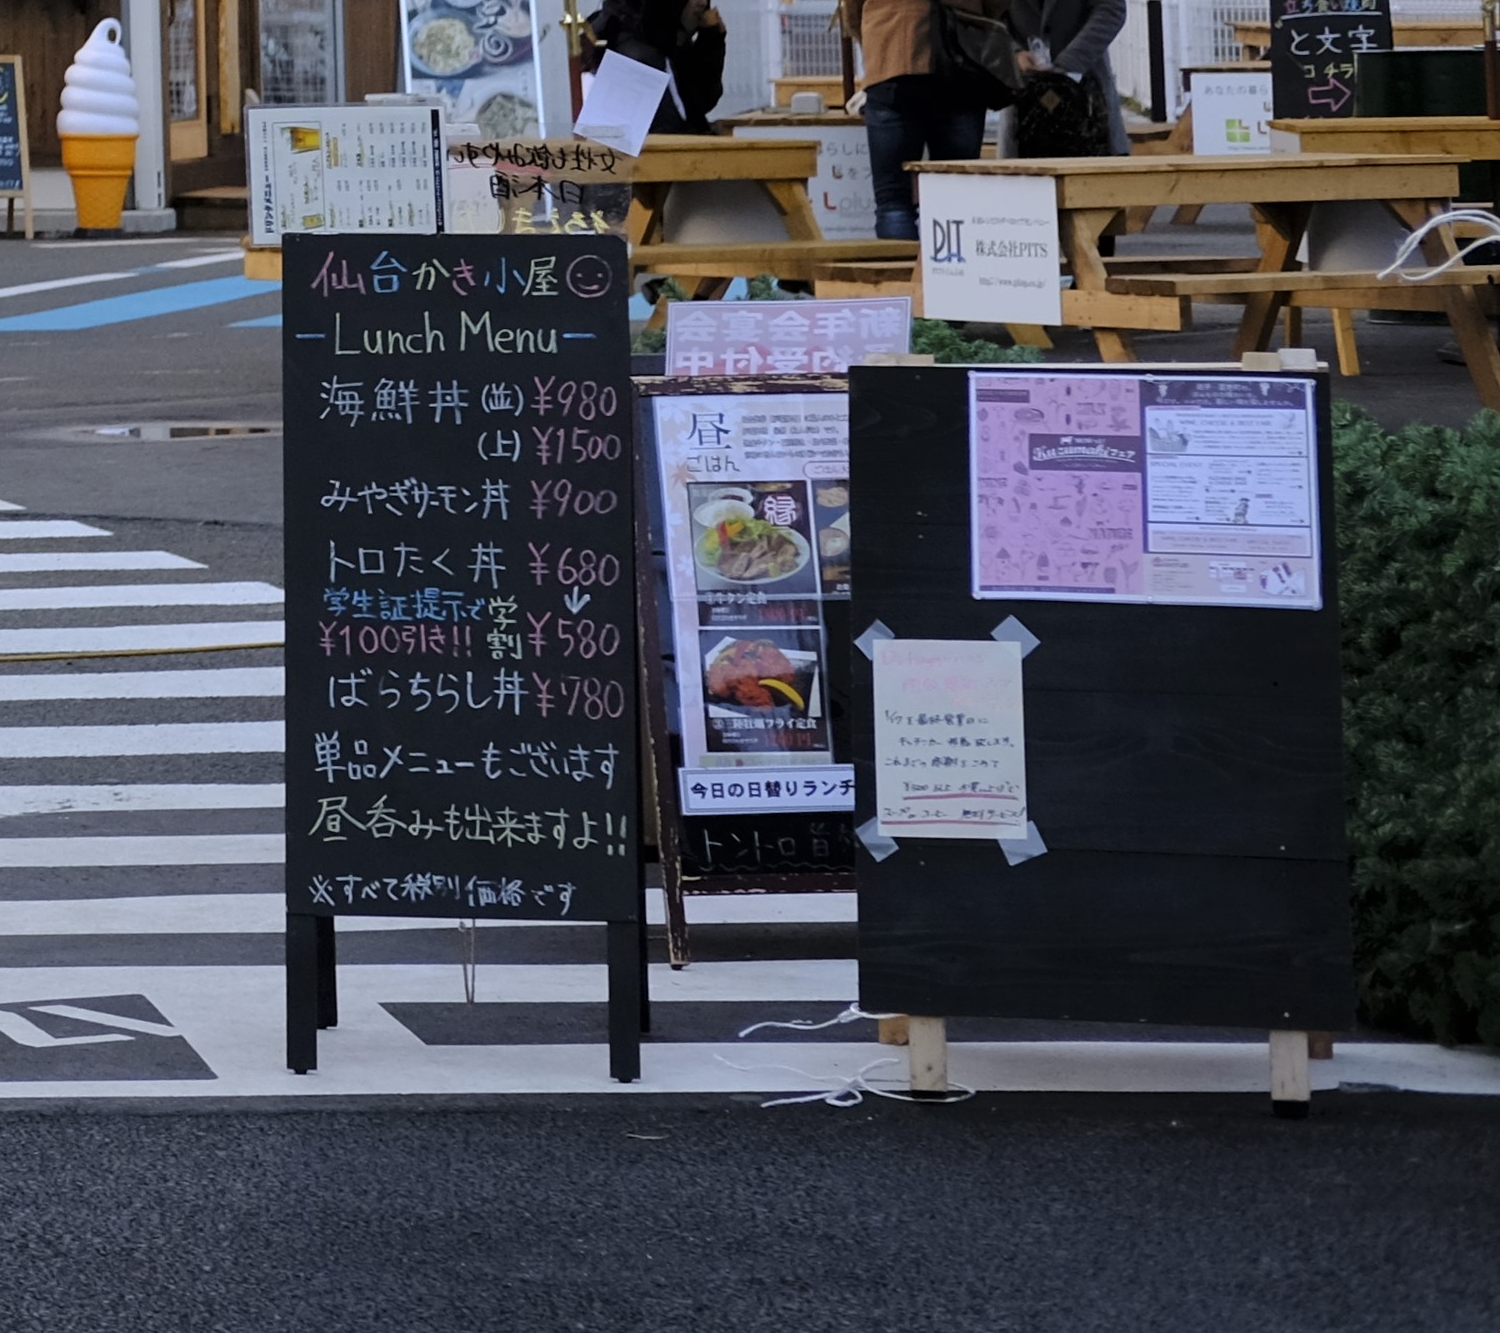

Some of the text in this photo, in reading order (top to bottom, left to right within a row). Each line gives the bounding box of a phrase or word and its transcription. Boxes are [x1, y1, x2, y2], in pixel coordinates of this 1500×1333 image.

[975, 238, 1048, 259] 株式会社PITS
[311, 250, 559, 298] 仙台かき小屋
[334, 310, 558, 355] Lunch Menu
[531, 375, 618, 420] ¥980
[477, 426, 622, 465] (上) ¥1500
[687, 412, 732, 450] 昼
[686, 454, 741, 473] ごはん
[320, 477, 618, 521] みやぎサーモン丼 ¥900
[527, 541, 620, 586] ¥680
[323, 586, 486, 621] 学生証提示で
[526, 612, 620, 658] ¥580
[328, 667, 625, 720] ばらちらし丼 ¥780
[314, 731, 619, 790] 単品メニューもございます
[690, 779, 855, 800] 今日の日替りランチ
